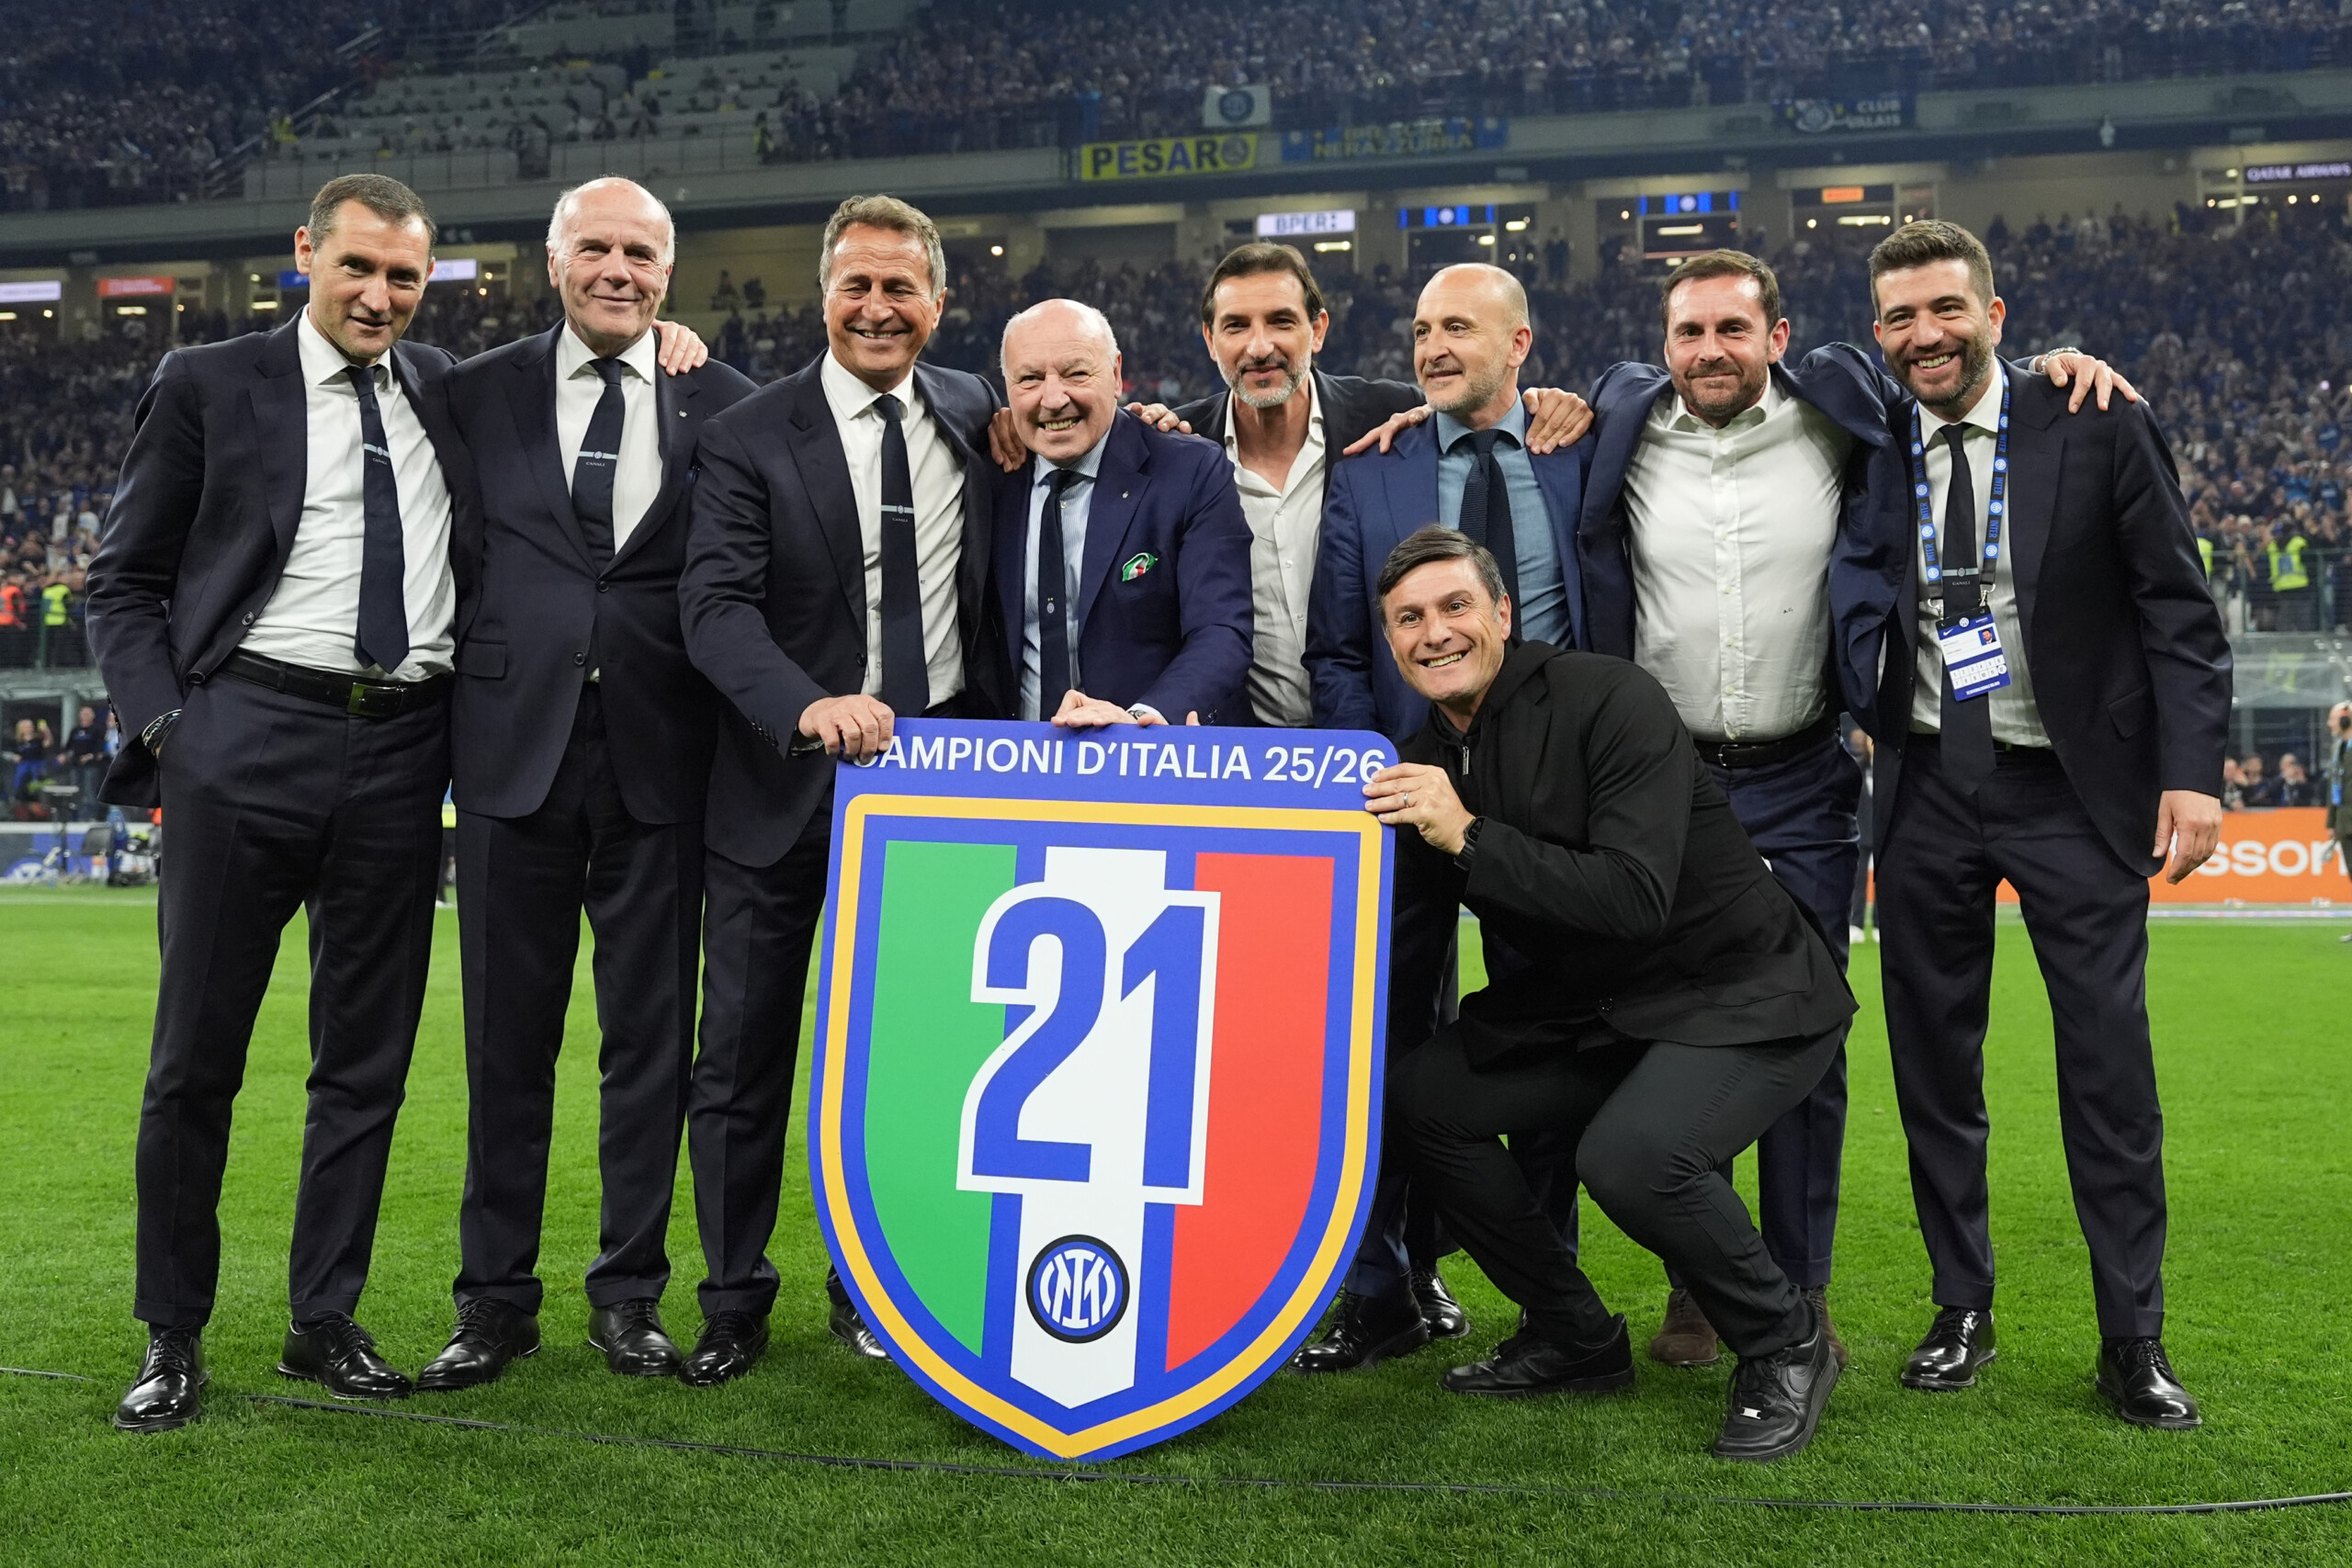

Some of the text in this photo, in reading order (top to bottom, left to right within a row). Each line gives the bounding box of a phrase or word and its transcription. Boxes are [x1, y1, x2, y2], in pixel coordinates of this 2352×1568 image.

[1993, 477, 2004, 495] INTER
[1919, 501, 1929, 520] INTER
[1988, 519, 1999, 538] INTER
[1925, 543, 1936, 561] INTER
[1077, 741, 1252, 780] D'ITALIA
[1262, 745, 1386, 788] 25/26
[971, 896, 1205, 1189] 21
